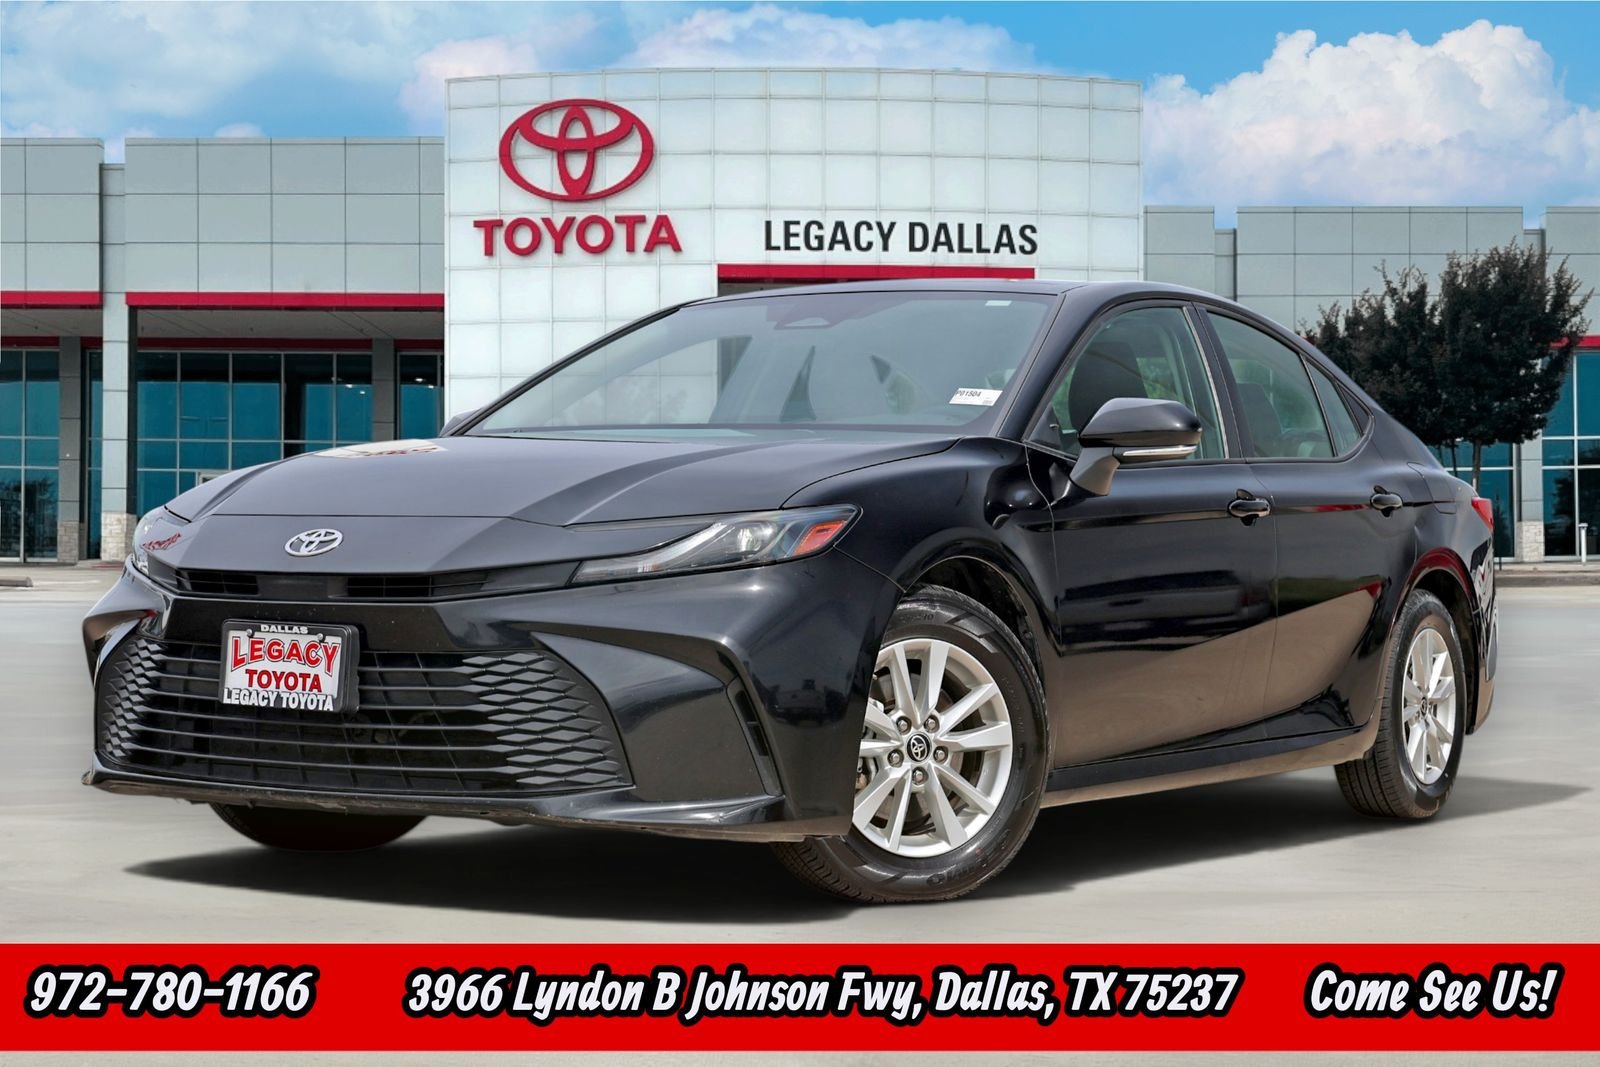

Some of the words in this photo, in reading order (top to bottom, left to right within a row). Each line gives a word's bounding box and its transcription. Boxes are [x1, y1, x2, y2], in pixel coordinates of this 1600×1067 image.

[473, 214, 682, 257] TOYOTA
[764, 220, 897, 252] LEGACY
[908, 222, 1038, 255] DALLAS
[261, 624, 308, 634] DALLAS
[231, 636, 341, 677] LEGACY
[245, 668, 322, 693] TOYOTA
[223, 688, 277, 707] LEGACY
[281, 692, 334, 711] TOYOTA
